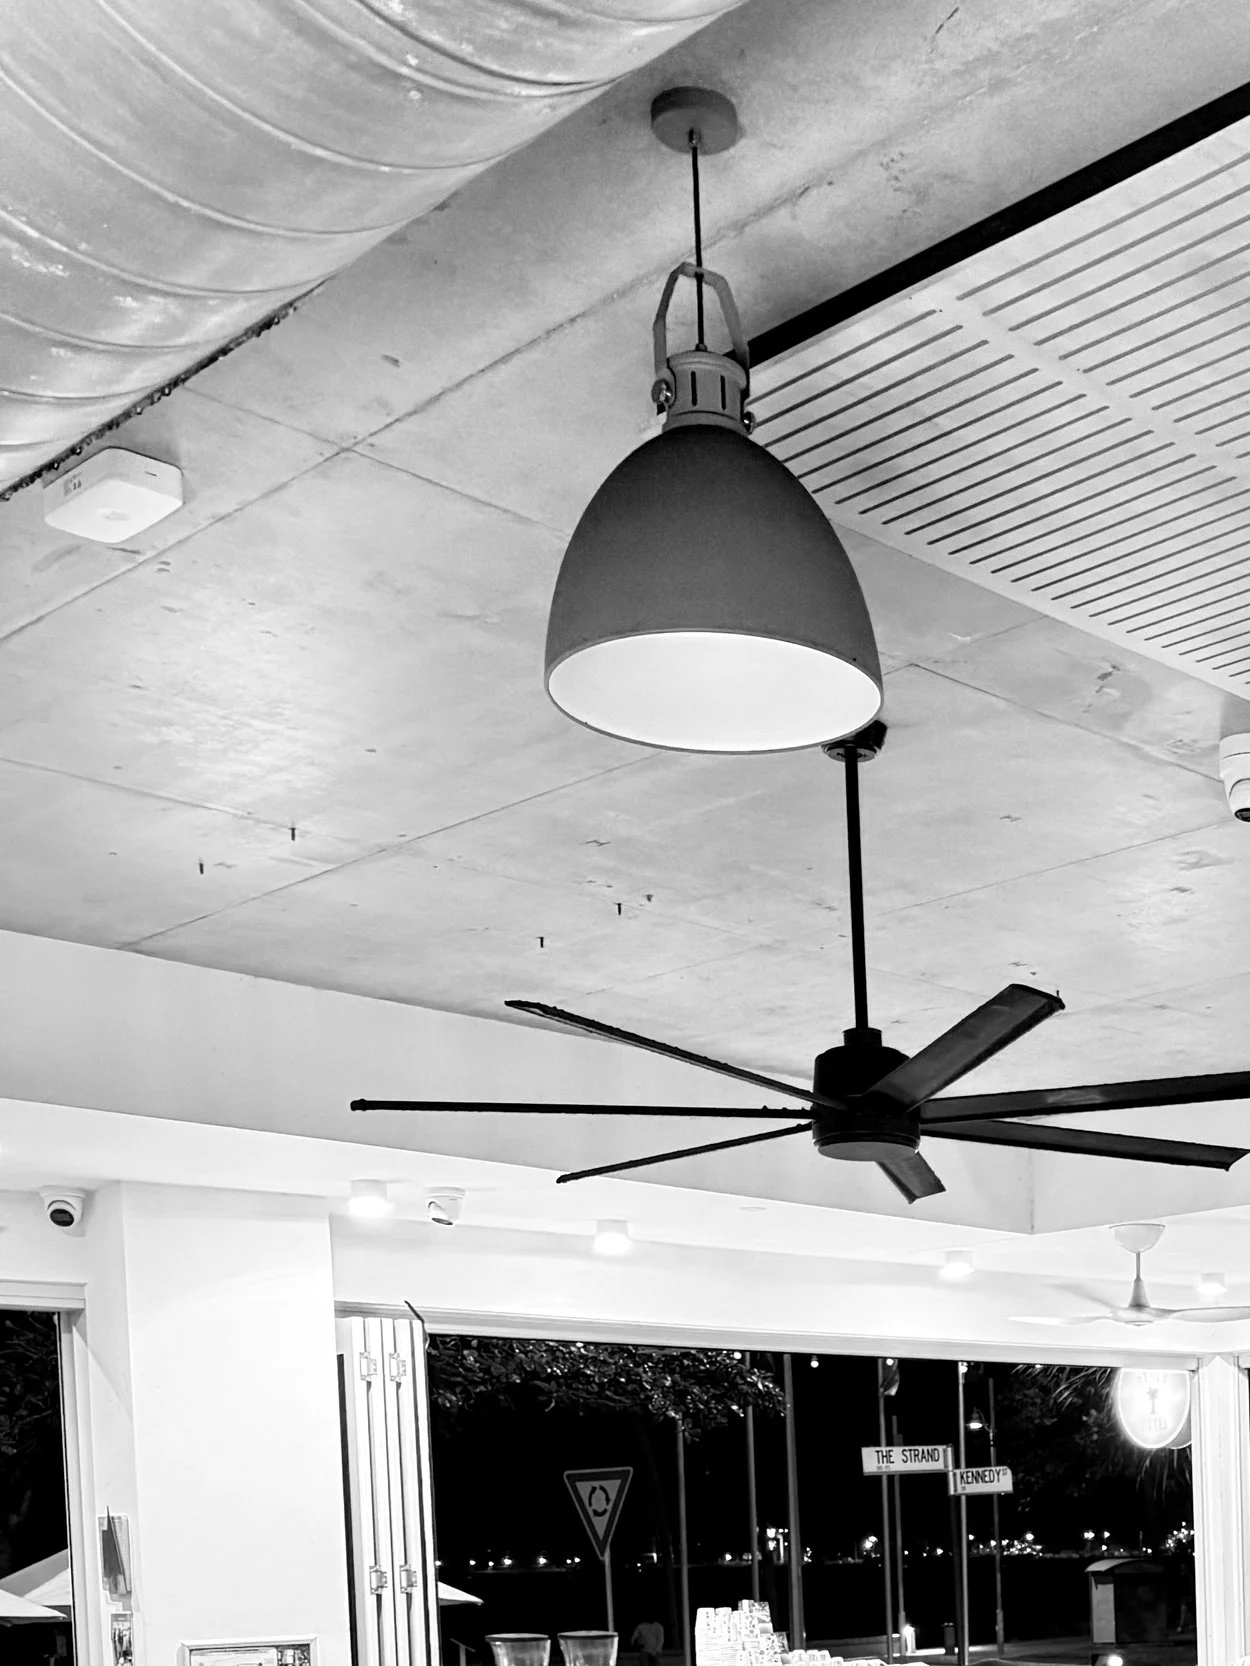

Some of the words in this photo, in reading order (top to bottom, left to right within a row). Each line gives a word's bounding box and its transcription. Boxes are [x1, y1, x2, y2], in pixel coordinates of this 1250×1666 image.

[875, 1450, 895, 1464] THE
[901, 1448, 940, 1464] STRAND
[960, 1468, 1001, 1485] KENNEDY
